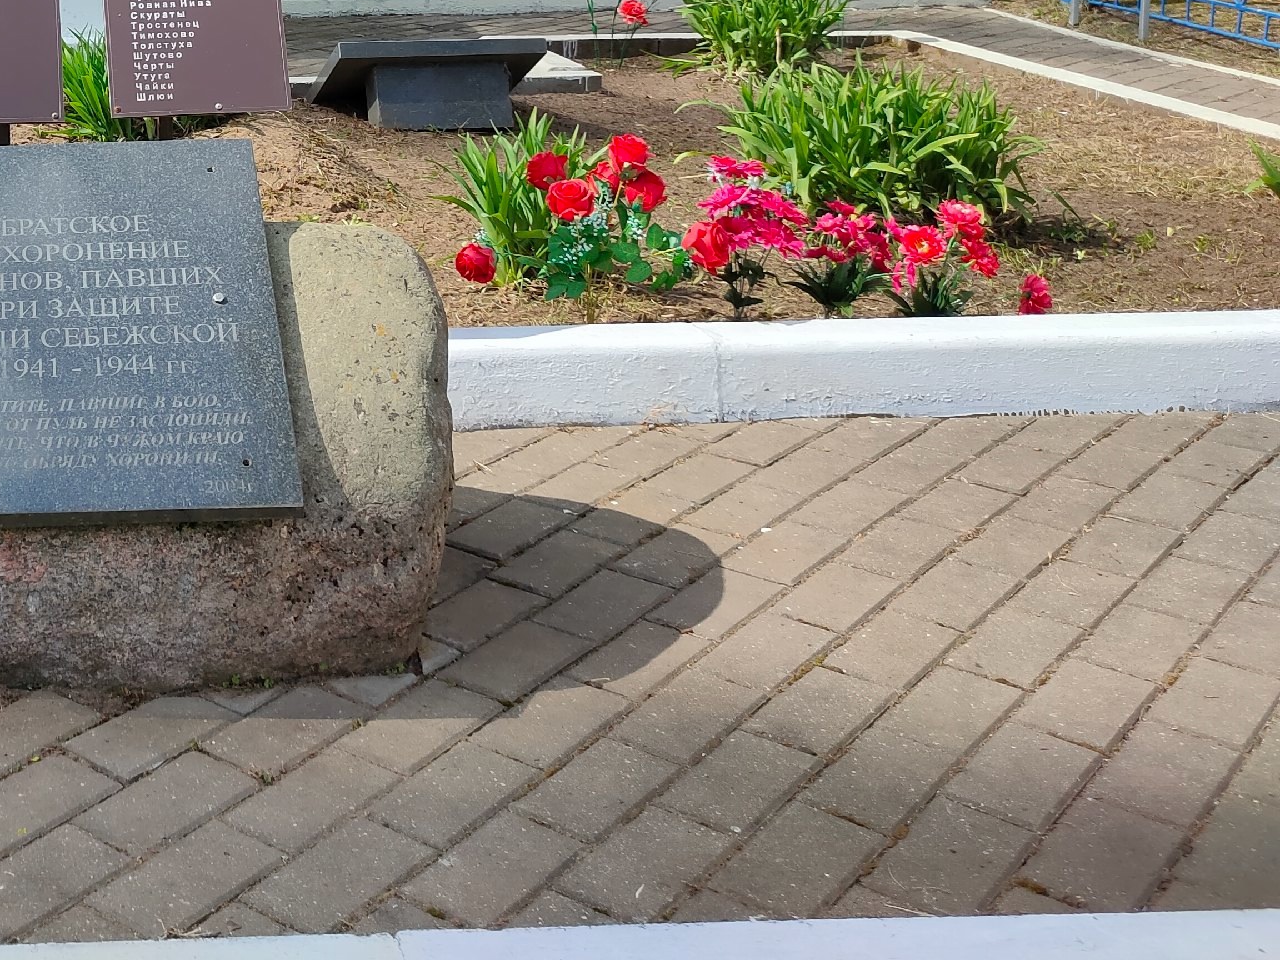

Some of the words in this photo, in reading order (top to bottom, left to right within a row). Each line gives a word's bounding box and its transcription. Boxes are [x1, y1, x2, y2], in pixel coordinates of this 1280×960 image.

[130, 2, 176, 10] Ровная
[180, 0, 211, 7] Нива
[131, 11, 185, 21] Скураты
[131, 21, 199, 31] Тростенец
[131, 32, 194, 40] Тимохово
[132, 42, 192, 50] Толстуха
[133, 52, 182, 61] Шутово
[134, 62, 174, 71] Черты
[134, 73, 169, 82] Утуга
[136, 82, 173, 91] Чайки
[2, 213, 151, 237] БРАТСКОЕ
[81, 266, 223, 290] ПАВШИХ
[47, 295, 180, 320] ЗАЩИТЕ
[40, 318, 240, 349] СЕБЕЖСКОЙ
[0, 356, 60, 379] 1941
[93, 354, 154, 377] 1944
[6, 418, 33, 432] ОТ
[36, 416, 88, 431] ПУЛЬ
[93, 415, 122, 429] НЕ
